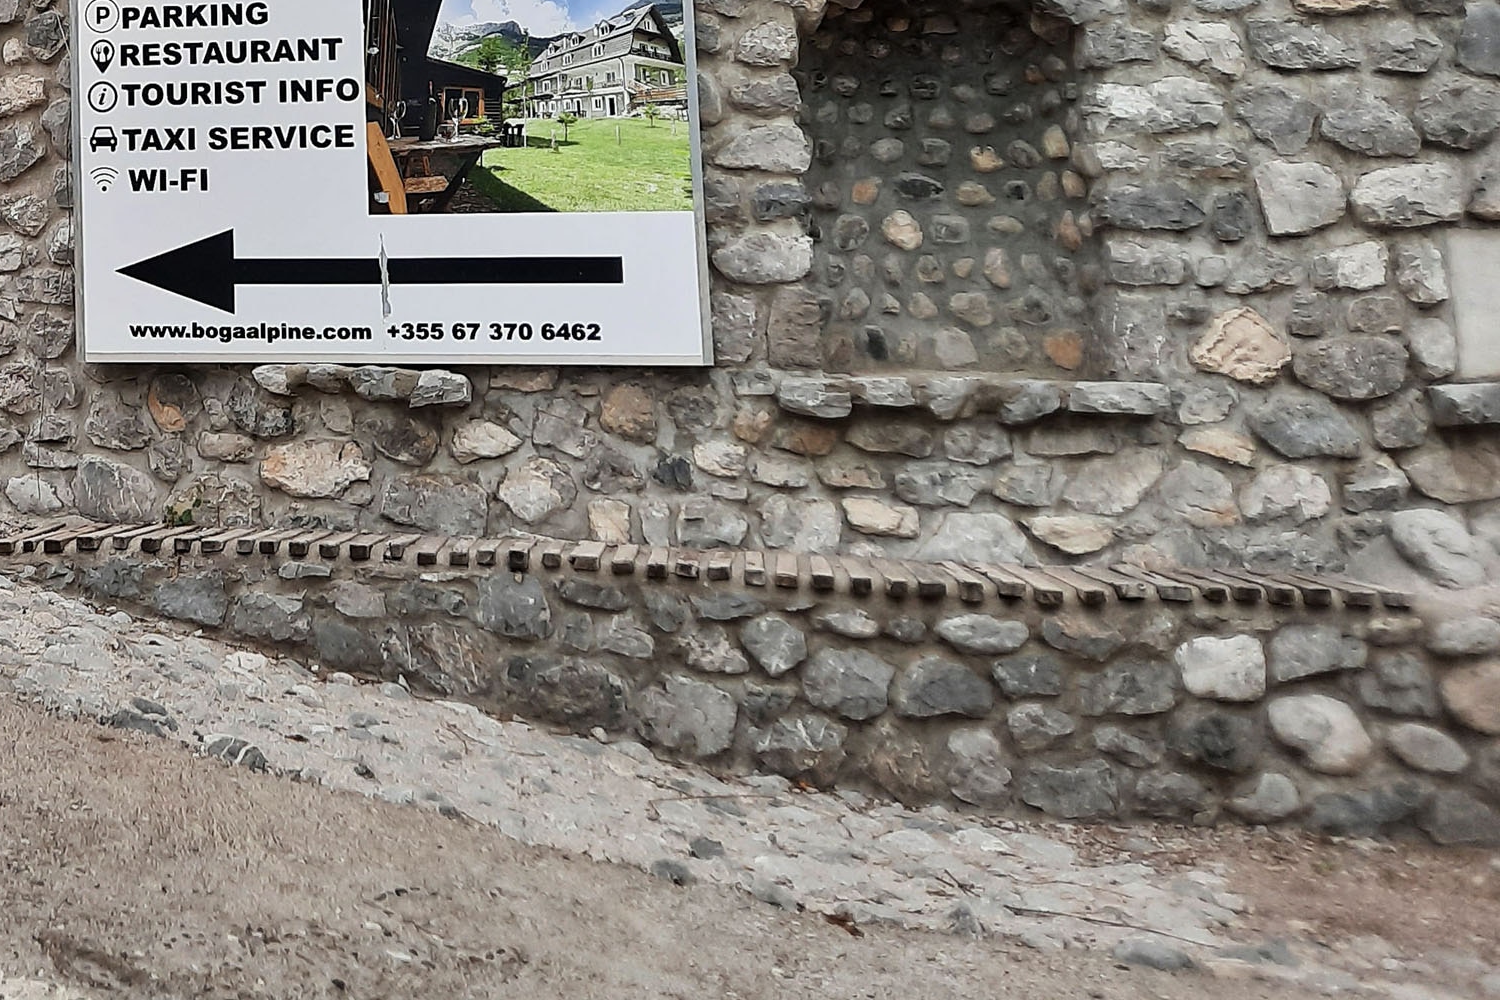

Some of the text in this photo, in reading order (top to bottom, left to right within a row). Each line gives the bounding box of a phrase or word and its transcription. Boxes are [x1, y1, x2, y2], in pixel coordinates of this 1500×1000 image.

[122, 2, 269, 29] PARKING
[120, 38, 342, 66] RESTAURANT
[121, 81, 266, 106] TOURIST
[279, 78, 359, 103] INFO
[122, 124, 355, 151] TAXI SERVICE
[128, 168, 208, 192] WI-FI
[130, 322, 601, 343] www.bogaalpine.com +355 67 370 6462
